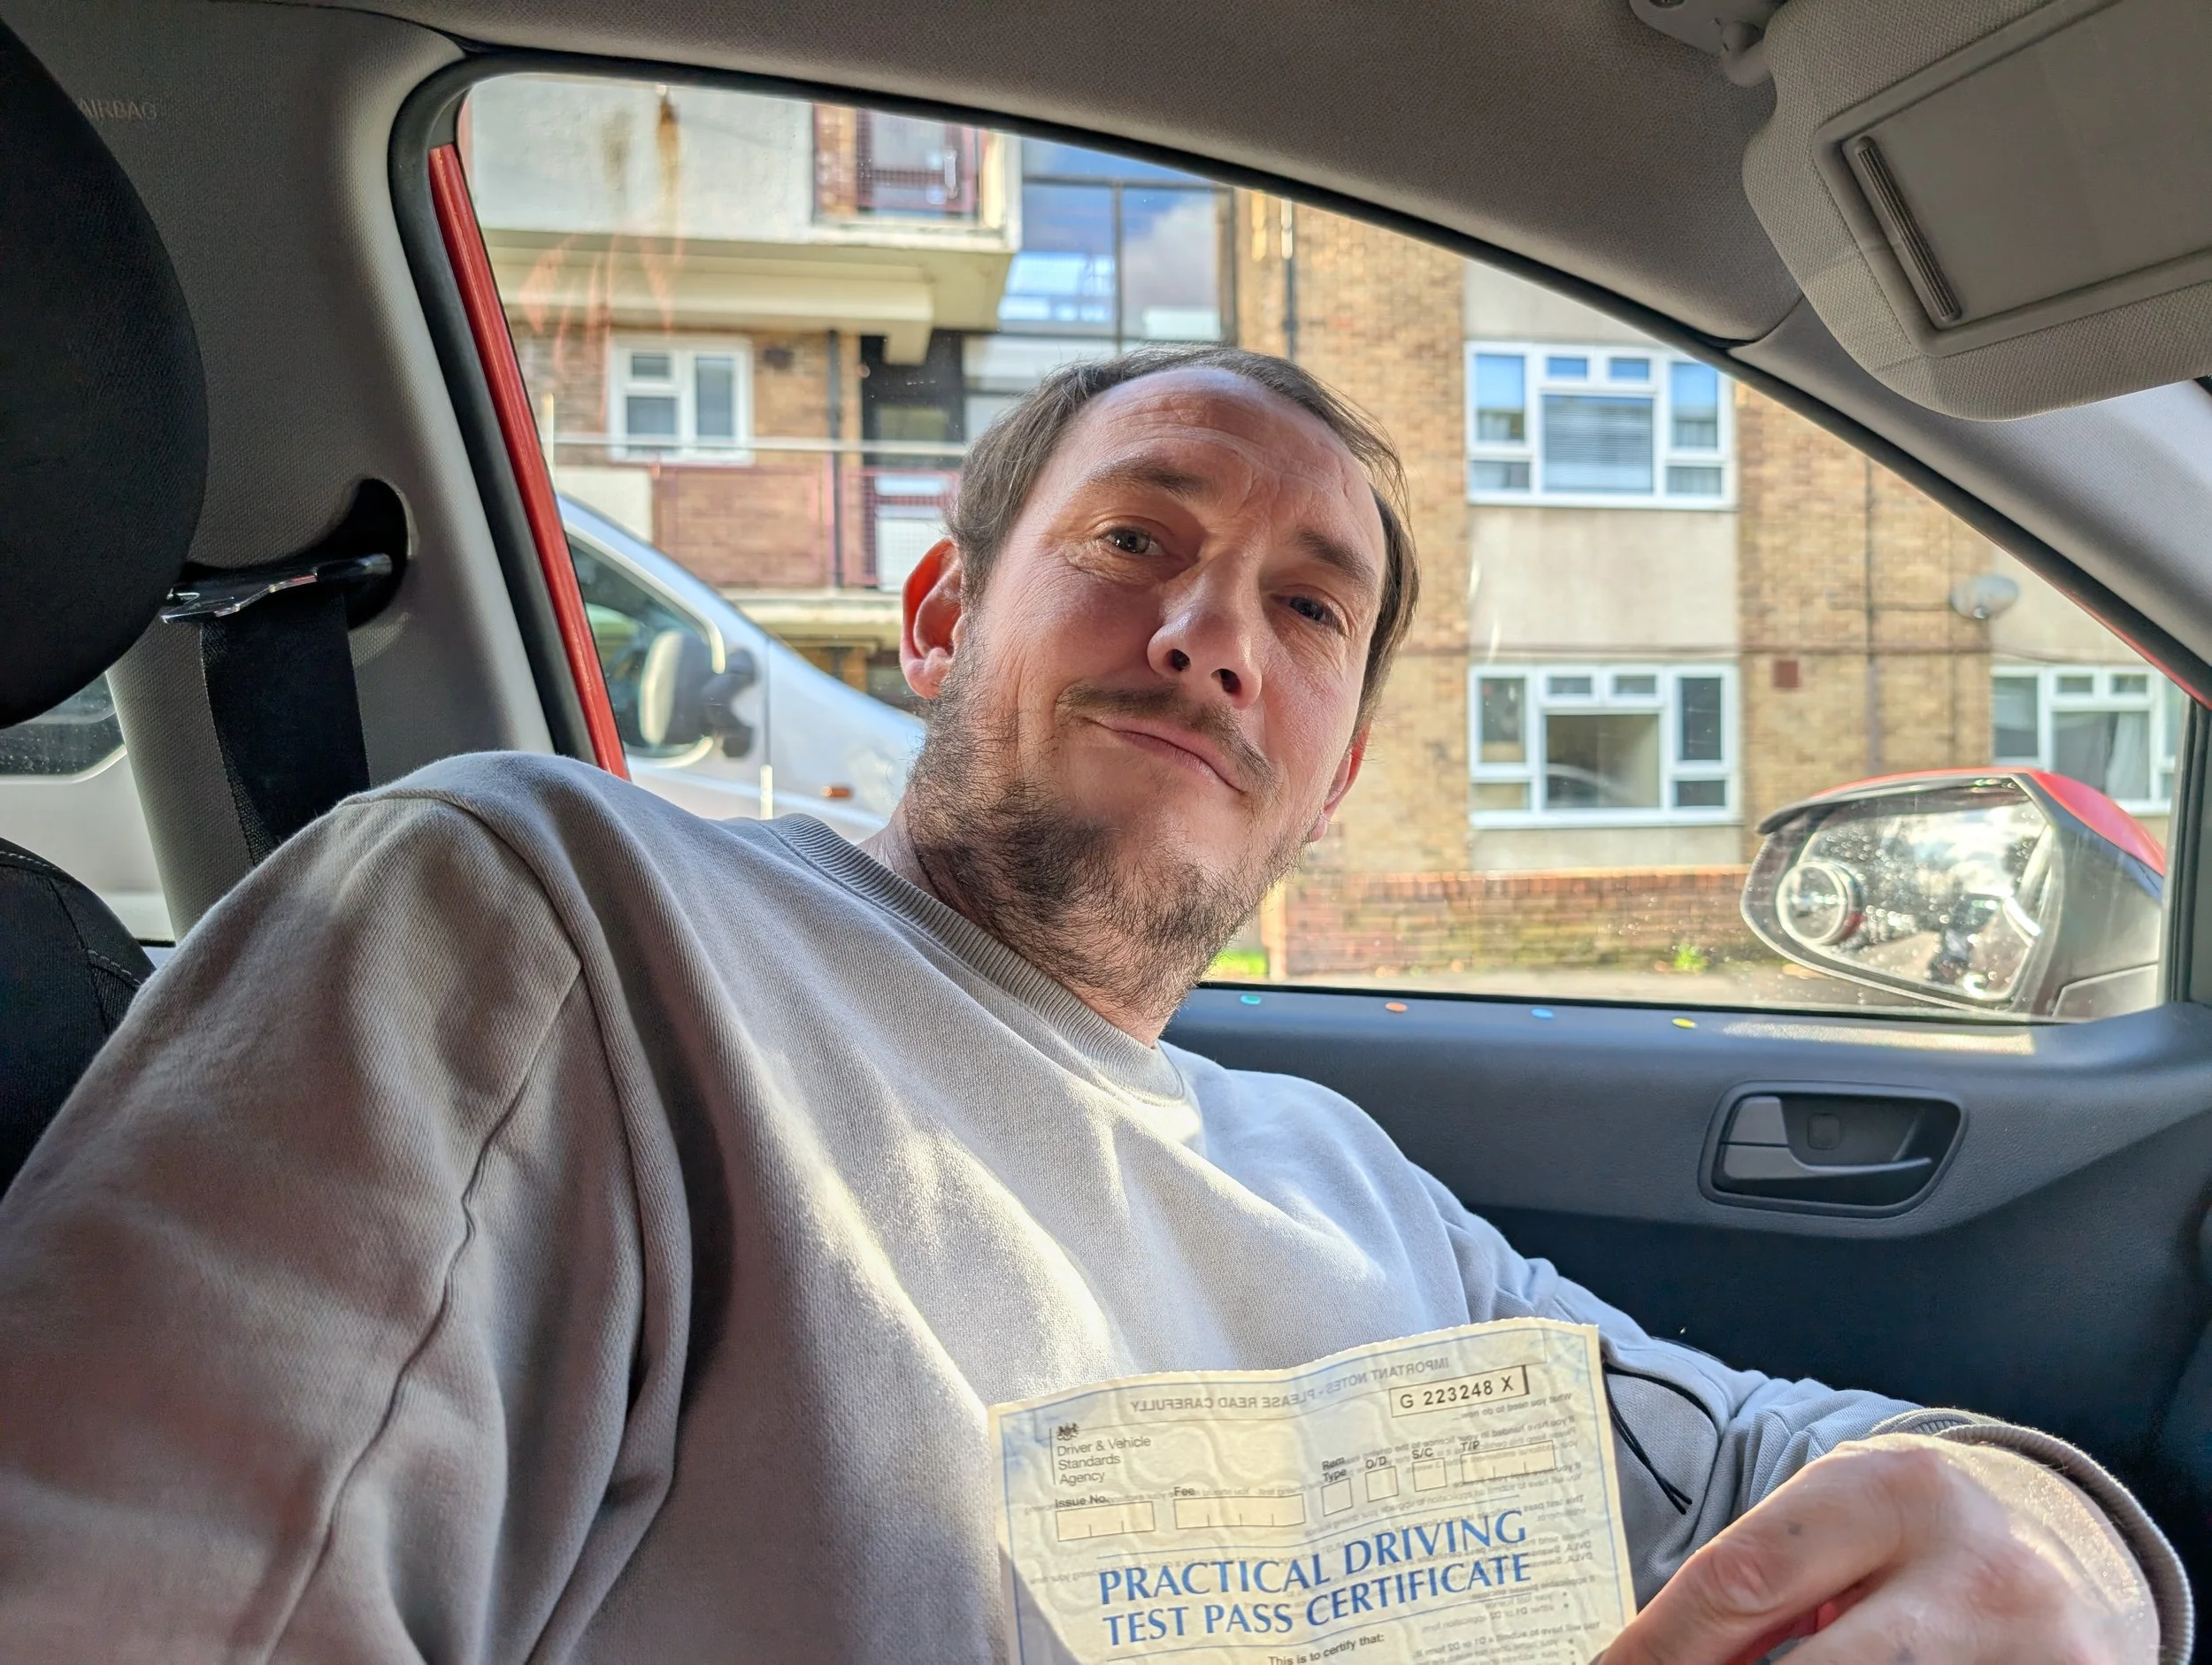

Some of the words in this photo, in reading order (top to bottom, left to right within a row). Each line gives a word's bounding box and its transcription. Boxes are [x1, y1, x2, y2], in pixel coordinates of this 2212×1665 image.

[1400, 1393, 1414, 1409] G
[1423, 1379, 1494, 1407] 223248
[1502, 1376, 1514, 1393] X
[1056, 1442, 1093, 1457] Driver
[1095, 1439, 1105, 1451] &
[1107, 1435, 1152, 1449] Vehicle
[1411, 1446, 1434, 1460] S/C
[1460, 1439, 1481, 1453] T/P
[1057, 1453, 1122, 1471] Standards
[1365, 1455, 1387, 1469] O/D
[1059, 1469, 1106, 1487] Agency
[1322, 1468, 1348, 1484] Type
[1174, 1486, 1195, 1496] Fee
[1055, 1498, 1087, 1508] Issue
[1099, 1553, 1332, 1605] PRACTICAL
[1343, 1509, 1525, 1576] DRIVING
[1102, 1606, 1190, 1646] TEST
[1204, 1602, 1294, 1634] PASS
[1306, 1552, 1532, 1627] CERTIFICATE
[1268, 1655, 1294, 1665] This
[1297, 1653, 1307, 1664] is
[1310, 1652, 1321, 1661] to
[1323, 1639, 1356, 1658] certify
[1359, 1633, 1386, 1646] that:
